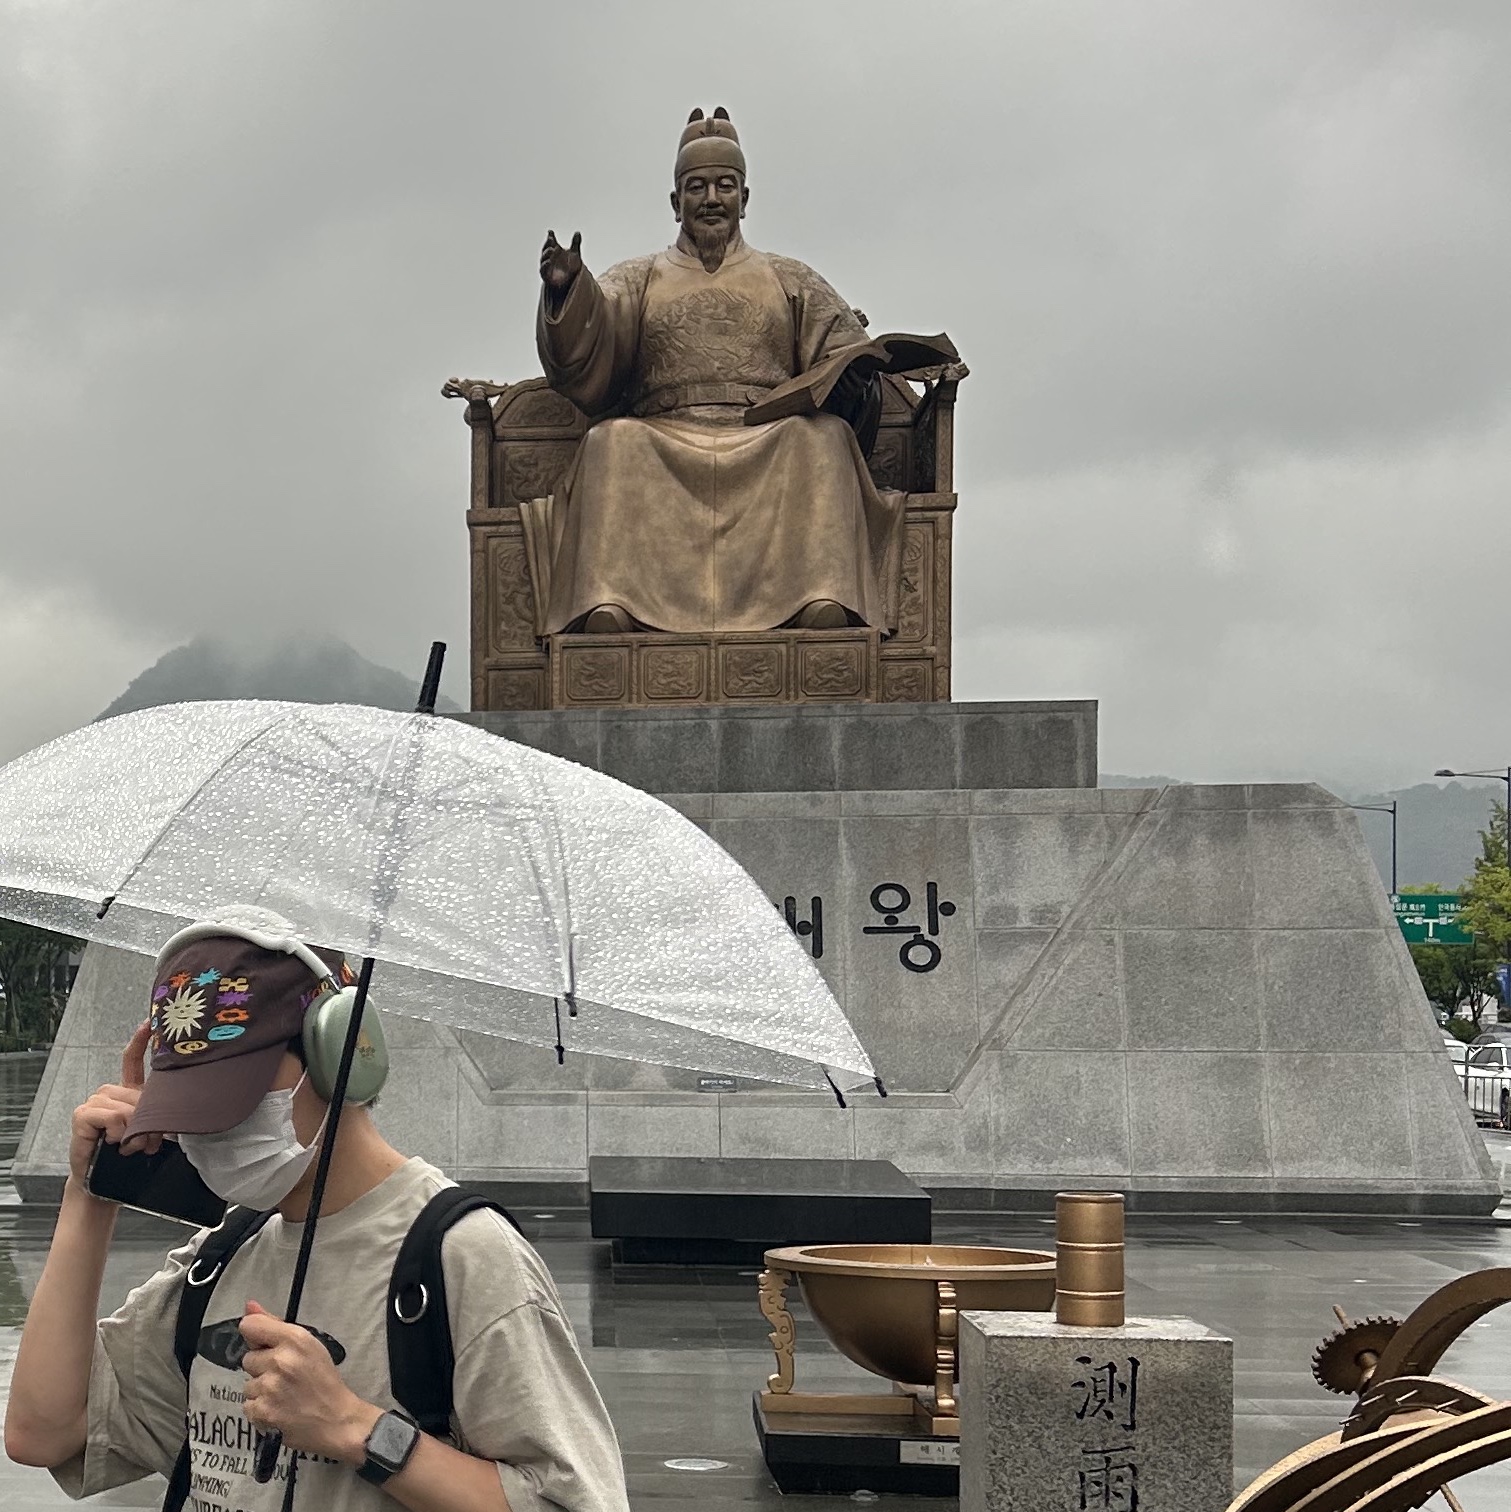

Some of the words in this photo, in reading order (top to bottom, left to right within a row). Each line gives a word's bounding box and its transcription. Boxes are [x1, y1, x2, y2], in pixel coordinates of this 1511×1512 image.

[188, 1410, 256, 1451] ALACH
[202, 1451, 219, 1469] TO
[219, 1454, 248, 1476] FALL
